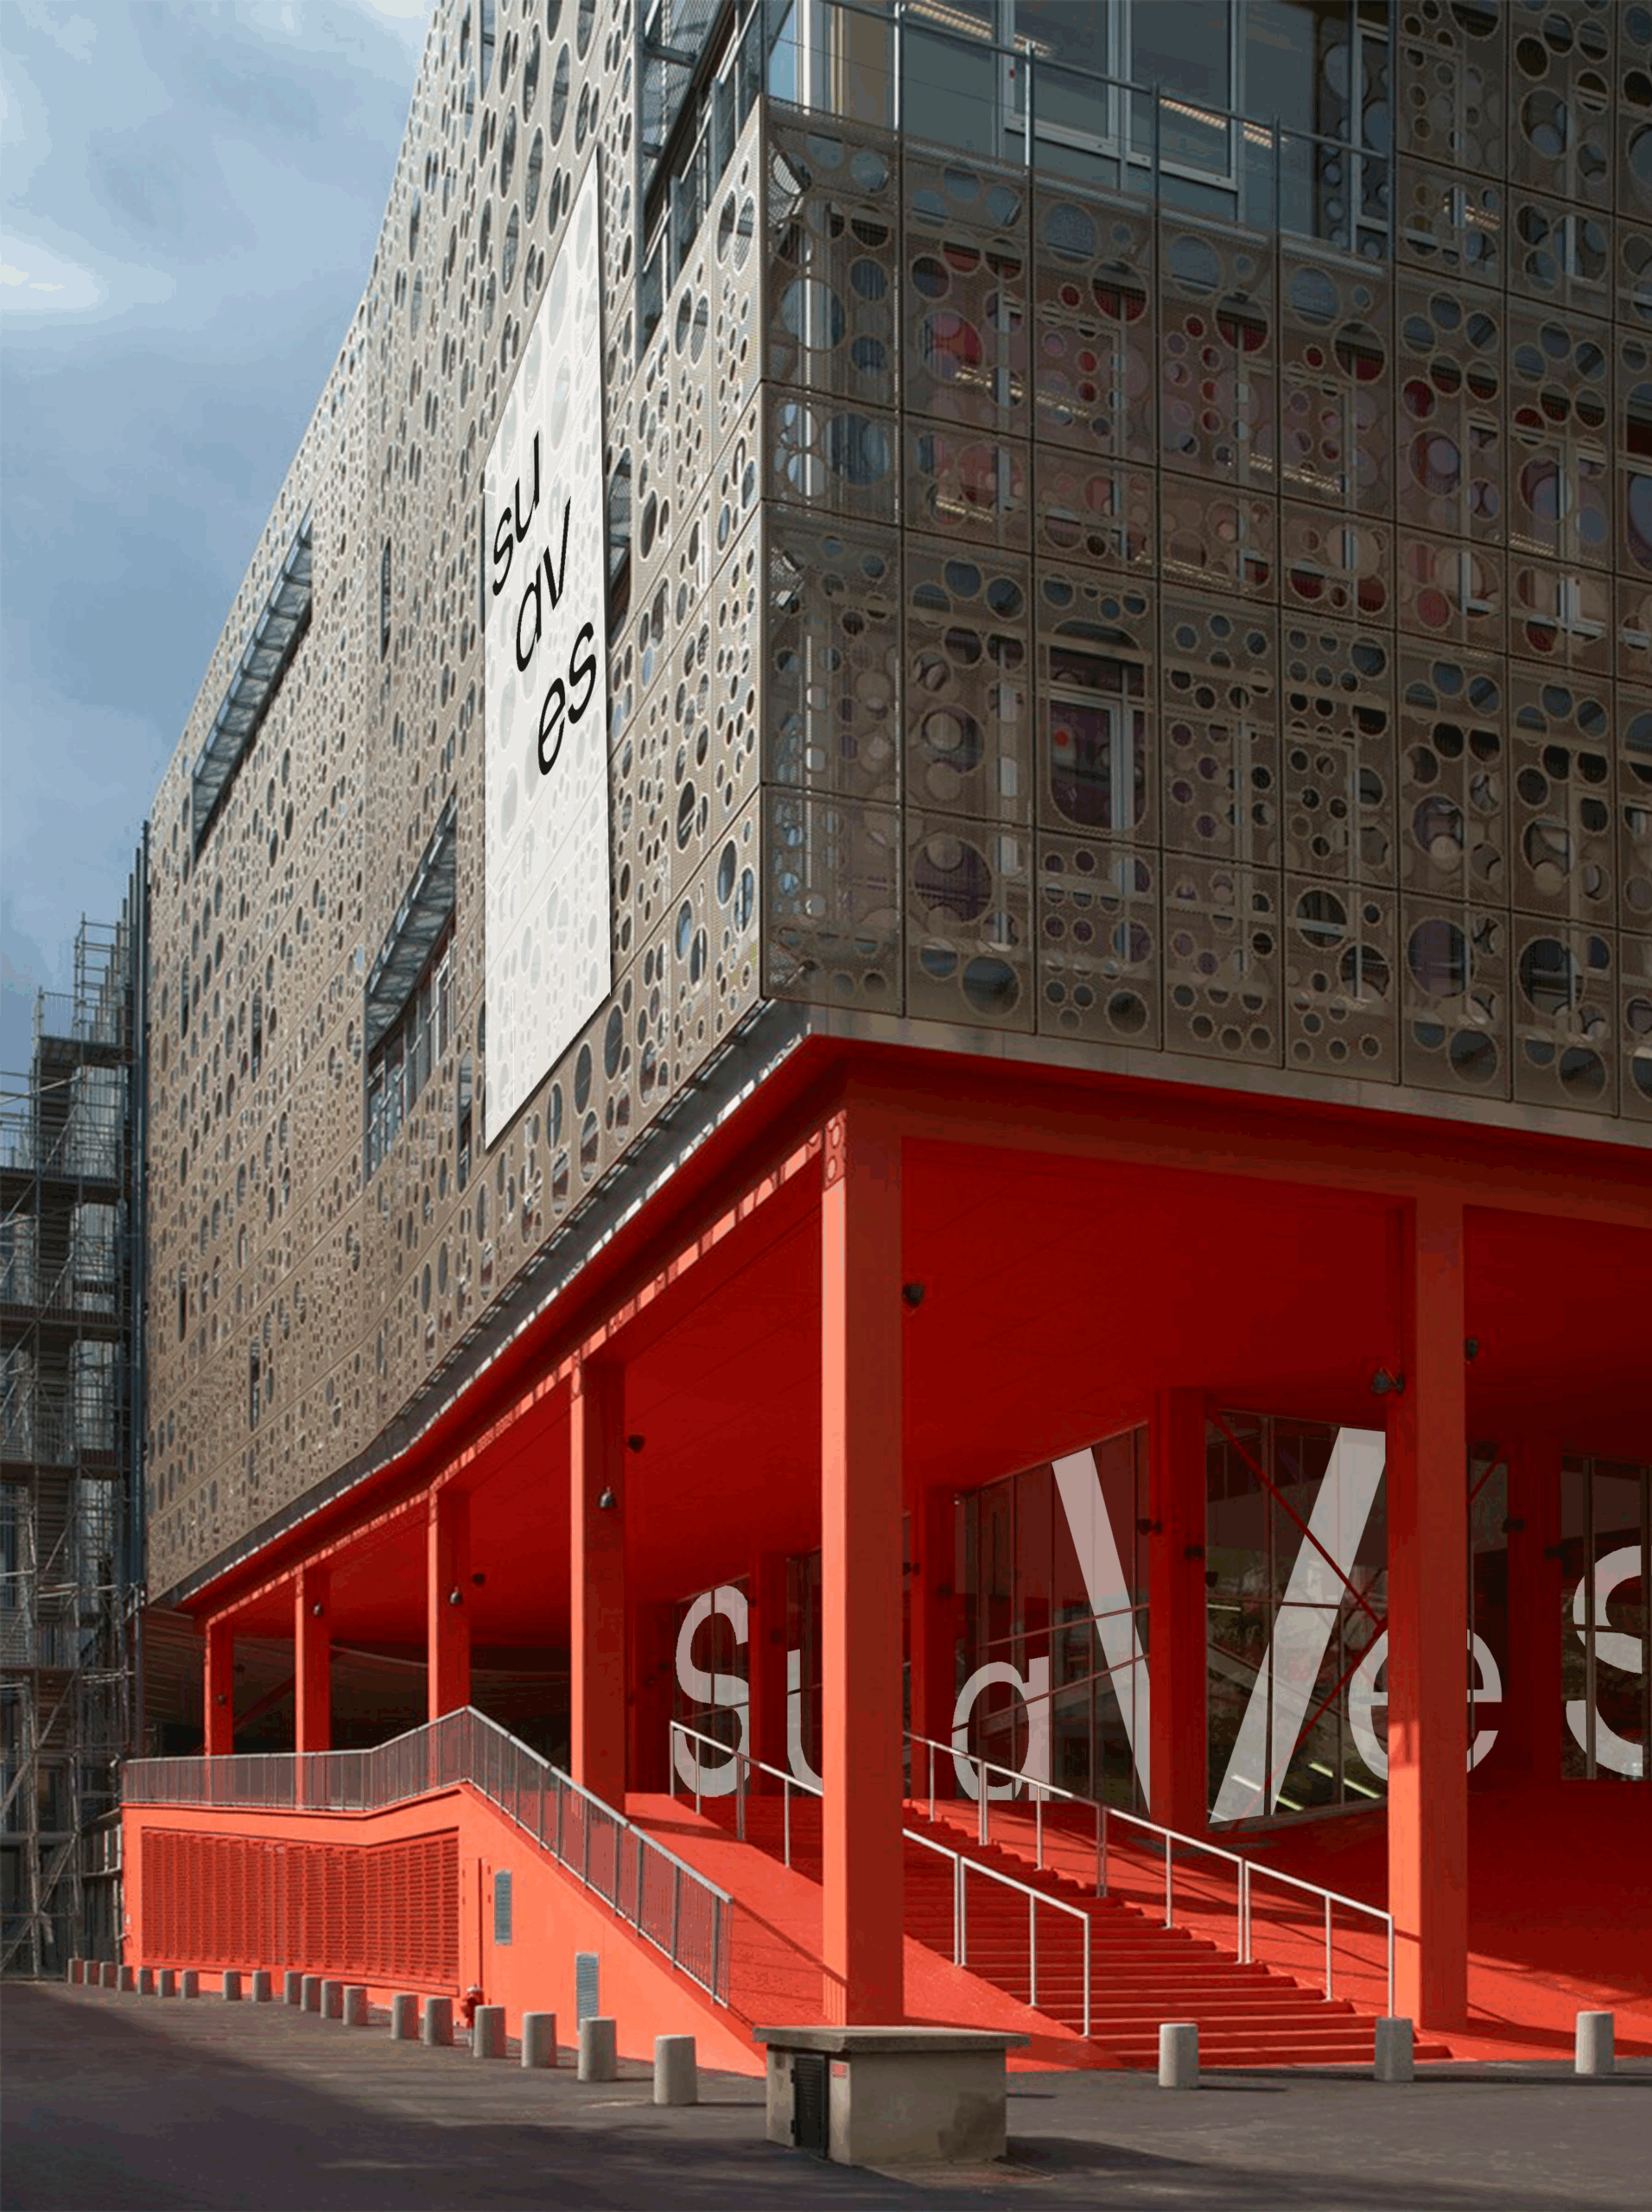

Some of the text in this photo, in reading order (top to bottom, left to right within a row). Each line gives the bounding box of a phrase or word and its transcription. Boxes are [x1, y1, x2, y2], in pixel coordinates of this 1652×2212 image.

[492, 430, 540, 596] su
[516, 496, 572, 672] av
[537, 621, 597, 776] es
